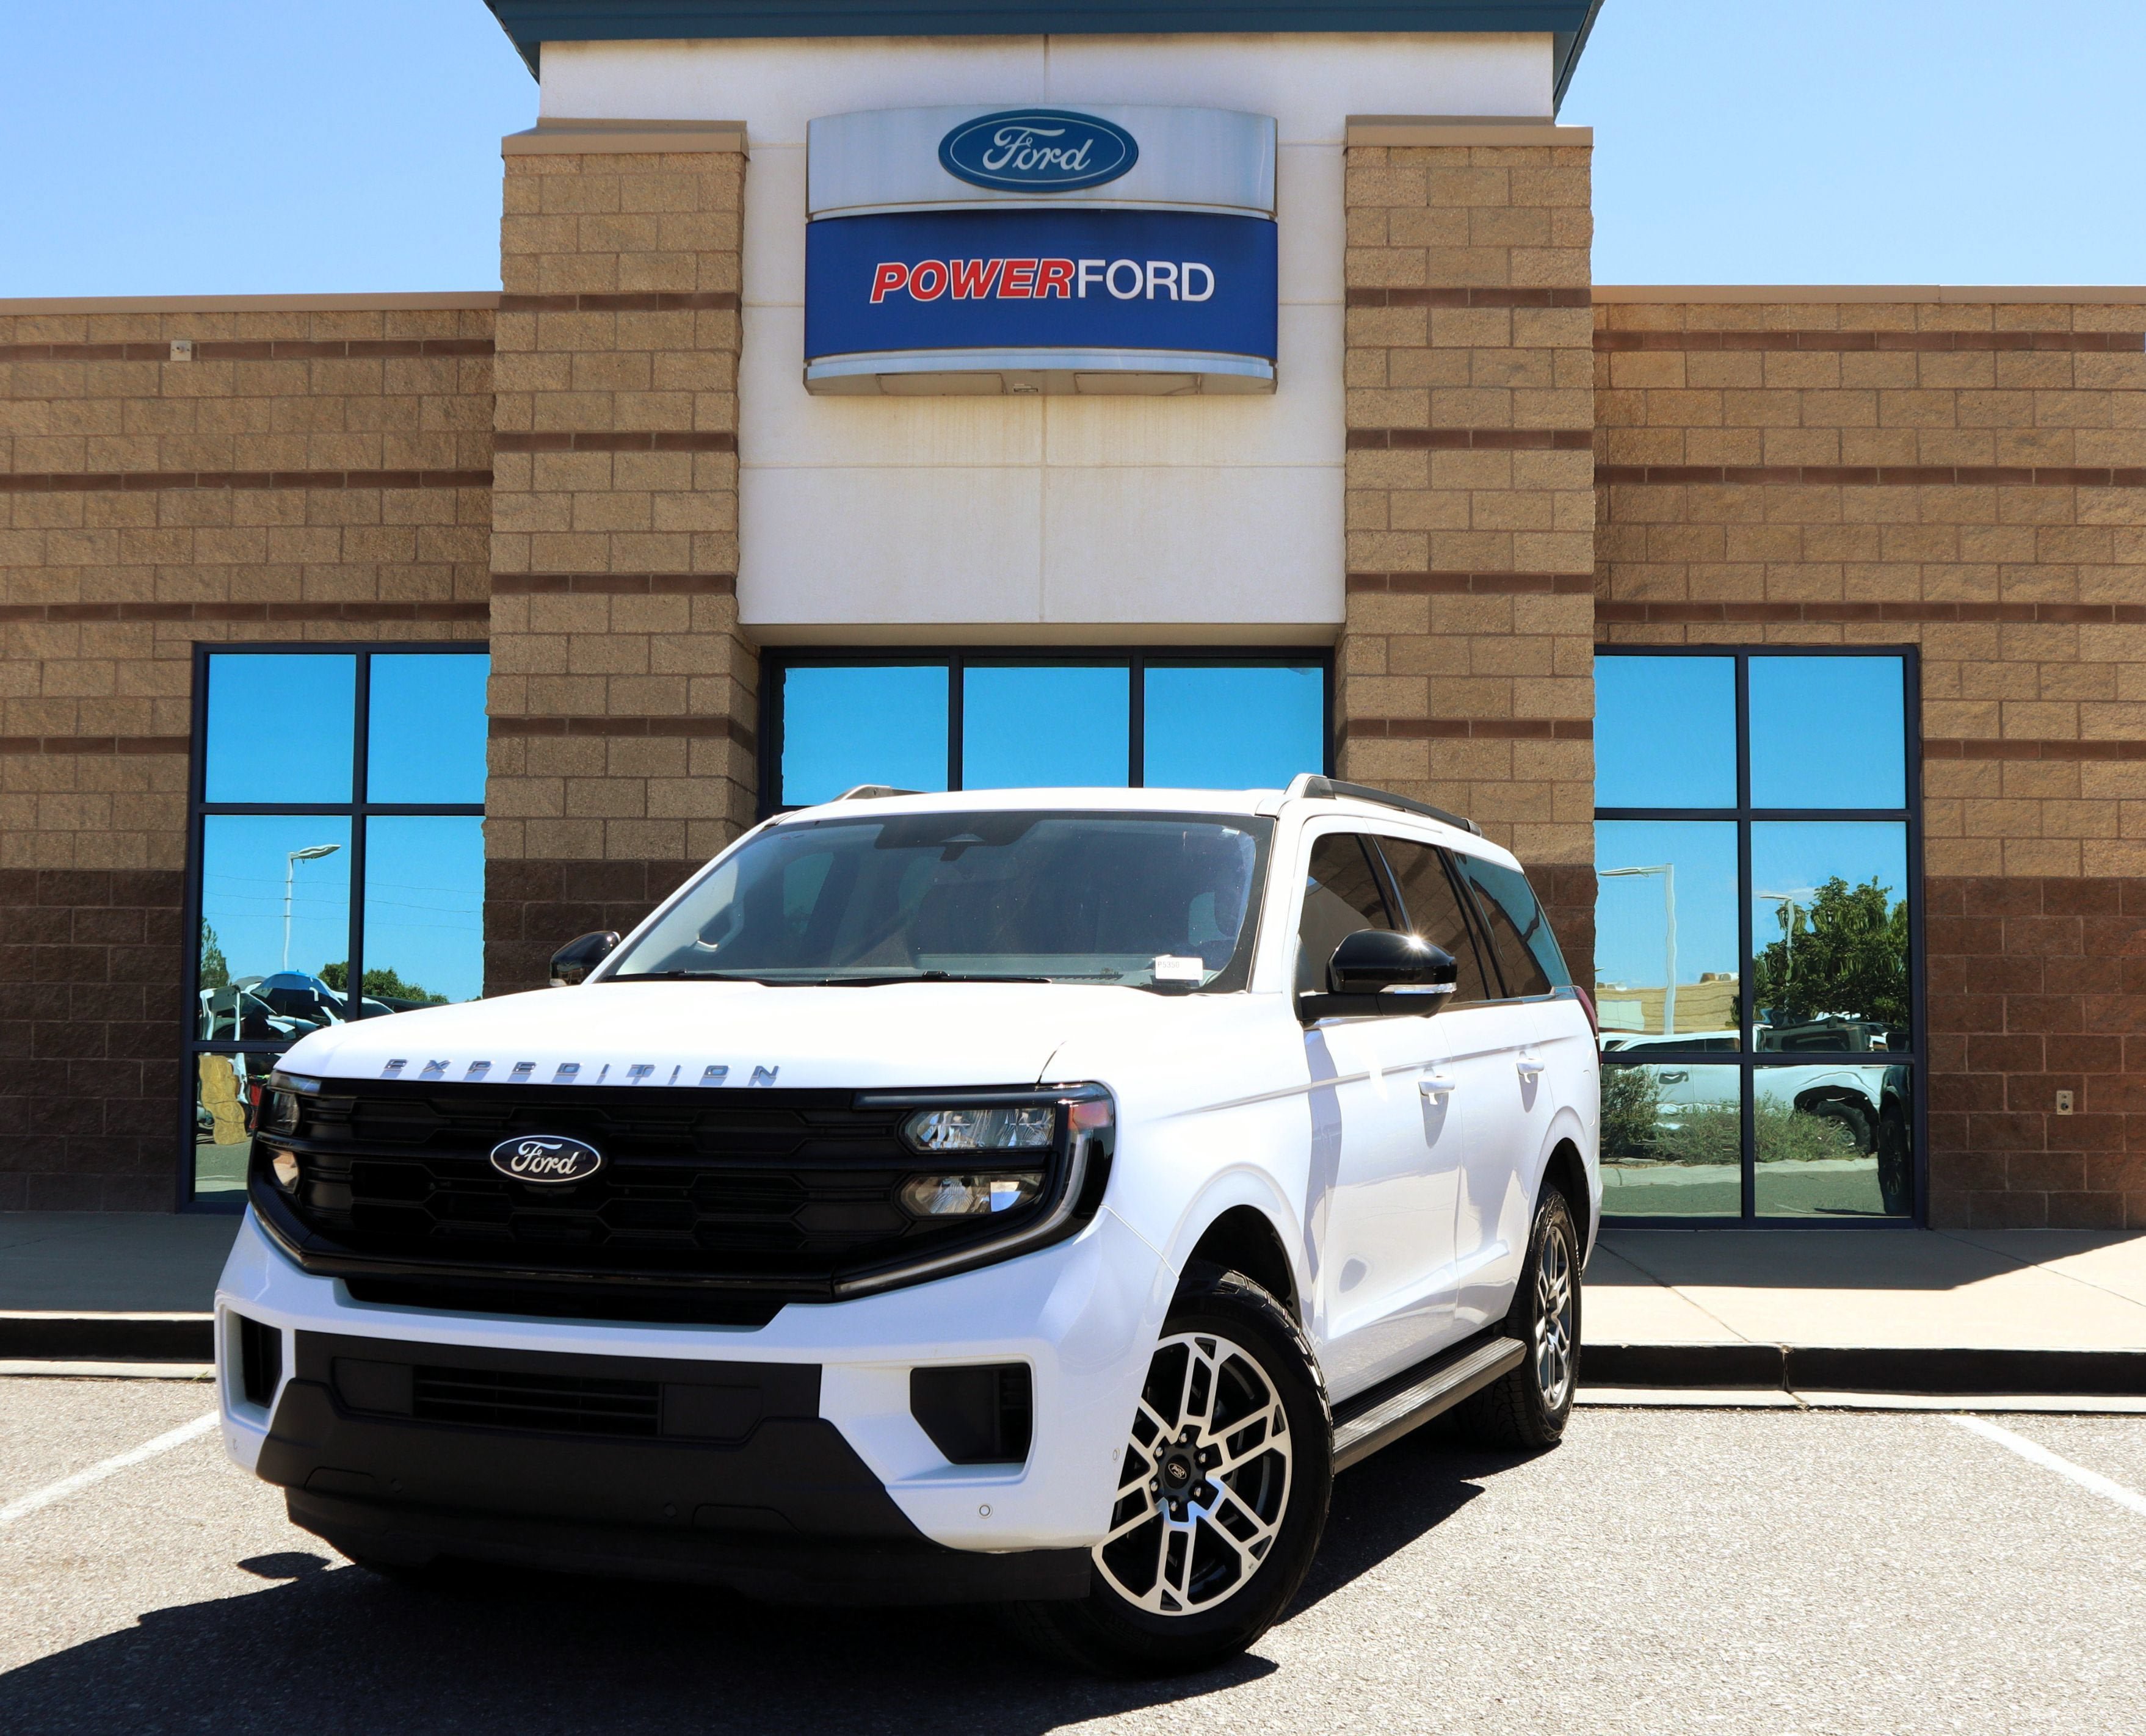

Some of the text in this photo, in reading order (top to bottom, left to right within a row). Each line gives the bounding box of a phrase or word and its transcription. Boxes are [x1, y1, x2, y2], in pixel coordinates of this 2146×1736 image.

[982, 125, 1093, 171] Ford
[383, 1058, 781, 1080] EXPEDITION
[510, 1141, 580, 1174] Ford
